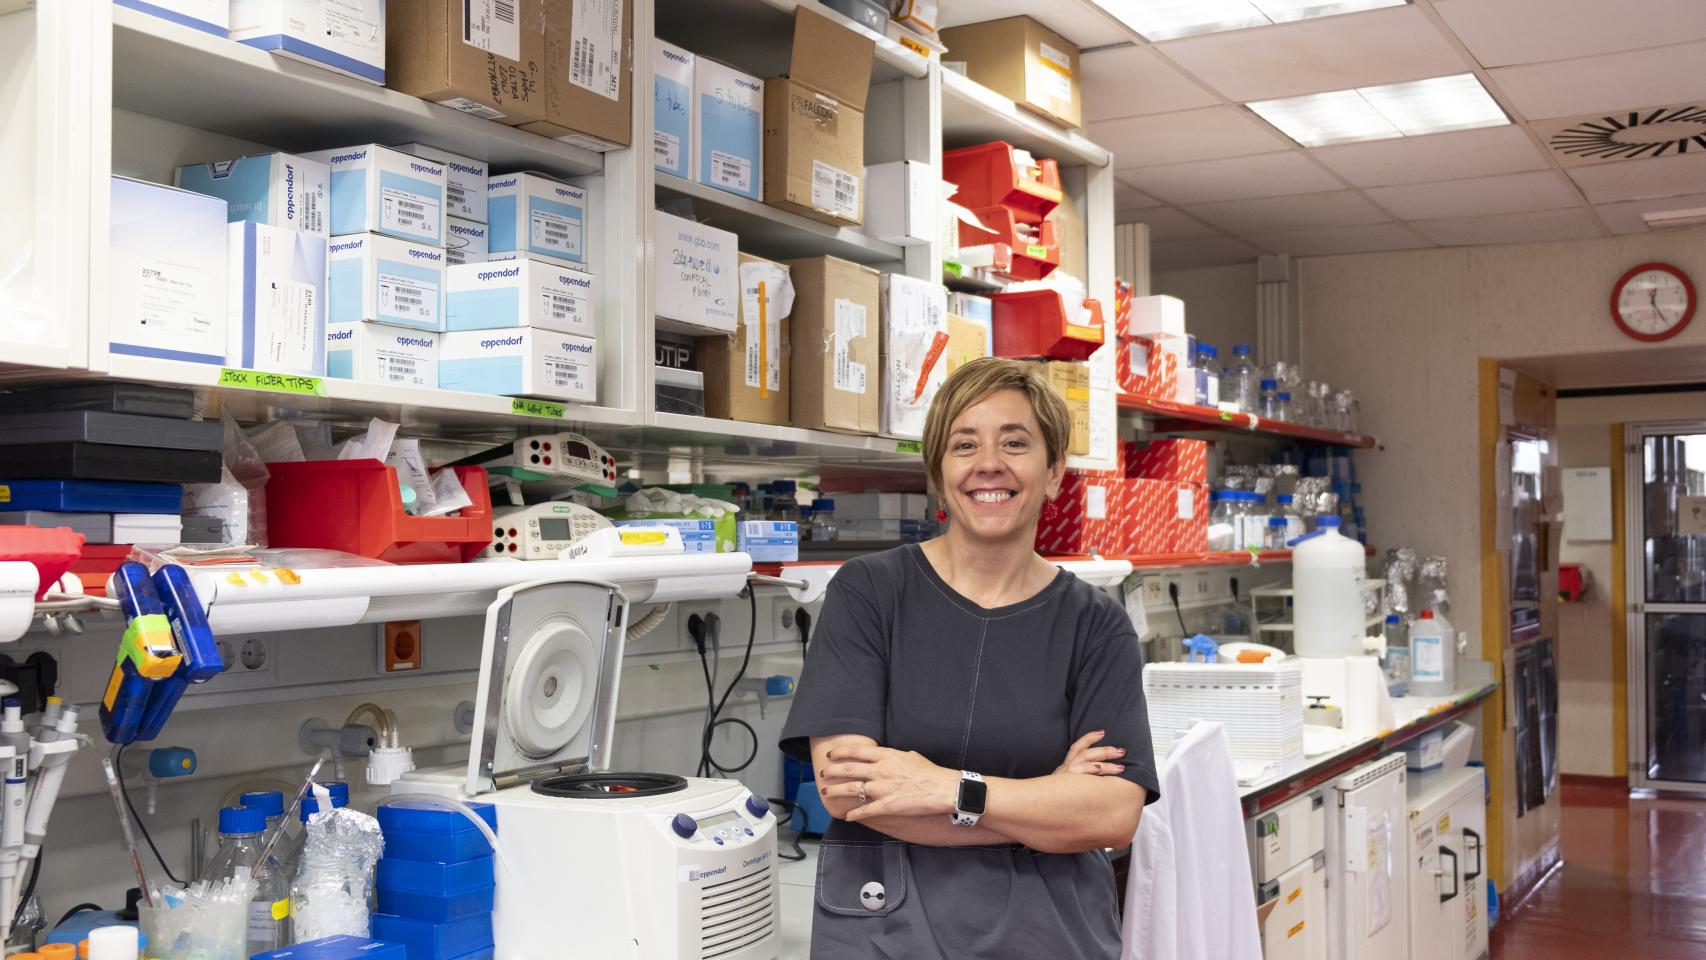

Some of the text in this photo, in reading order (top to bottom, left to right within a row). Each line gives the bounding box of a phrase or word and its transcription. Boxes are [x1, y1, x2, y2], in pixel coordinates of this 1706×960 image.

[804, 99, 833, 120] FALCON
[330, 150, 368, 164] eppendorf
[410, 161, 442, 177] eppendorf
[449, 161, 484, 176] eppendorf
[285, 163, 296, 221] eppendorf
[487, 178, 517, 192] ppendorf
[555, 187, 583, 200] eppendorf
[449, 223, 485, 238] eppendorf
[408, 248, 442, 263] eppendorf
[477, 266, 520, 282] eppendorf
[559, 274, 592, 289] eppendorf
[396, 334, 434, 350] eppendorf
[480, 335, 523, 349] eppendorf
[561, 341, 593, 355] eppendorf
[222, 371, 315, 391] STOCK FILTER TIPS
[699, 865, 728, 879] eppendorf
